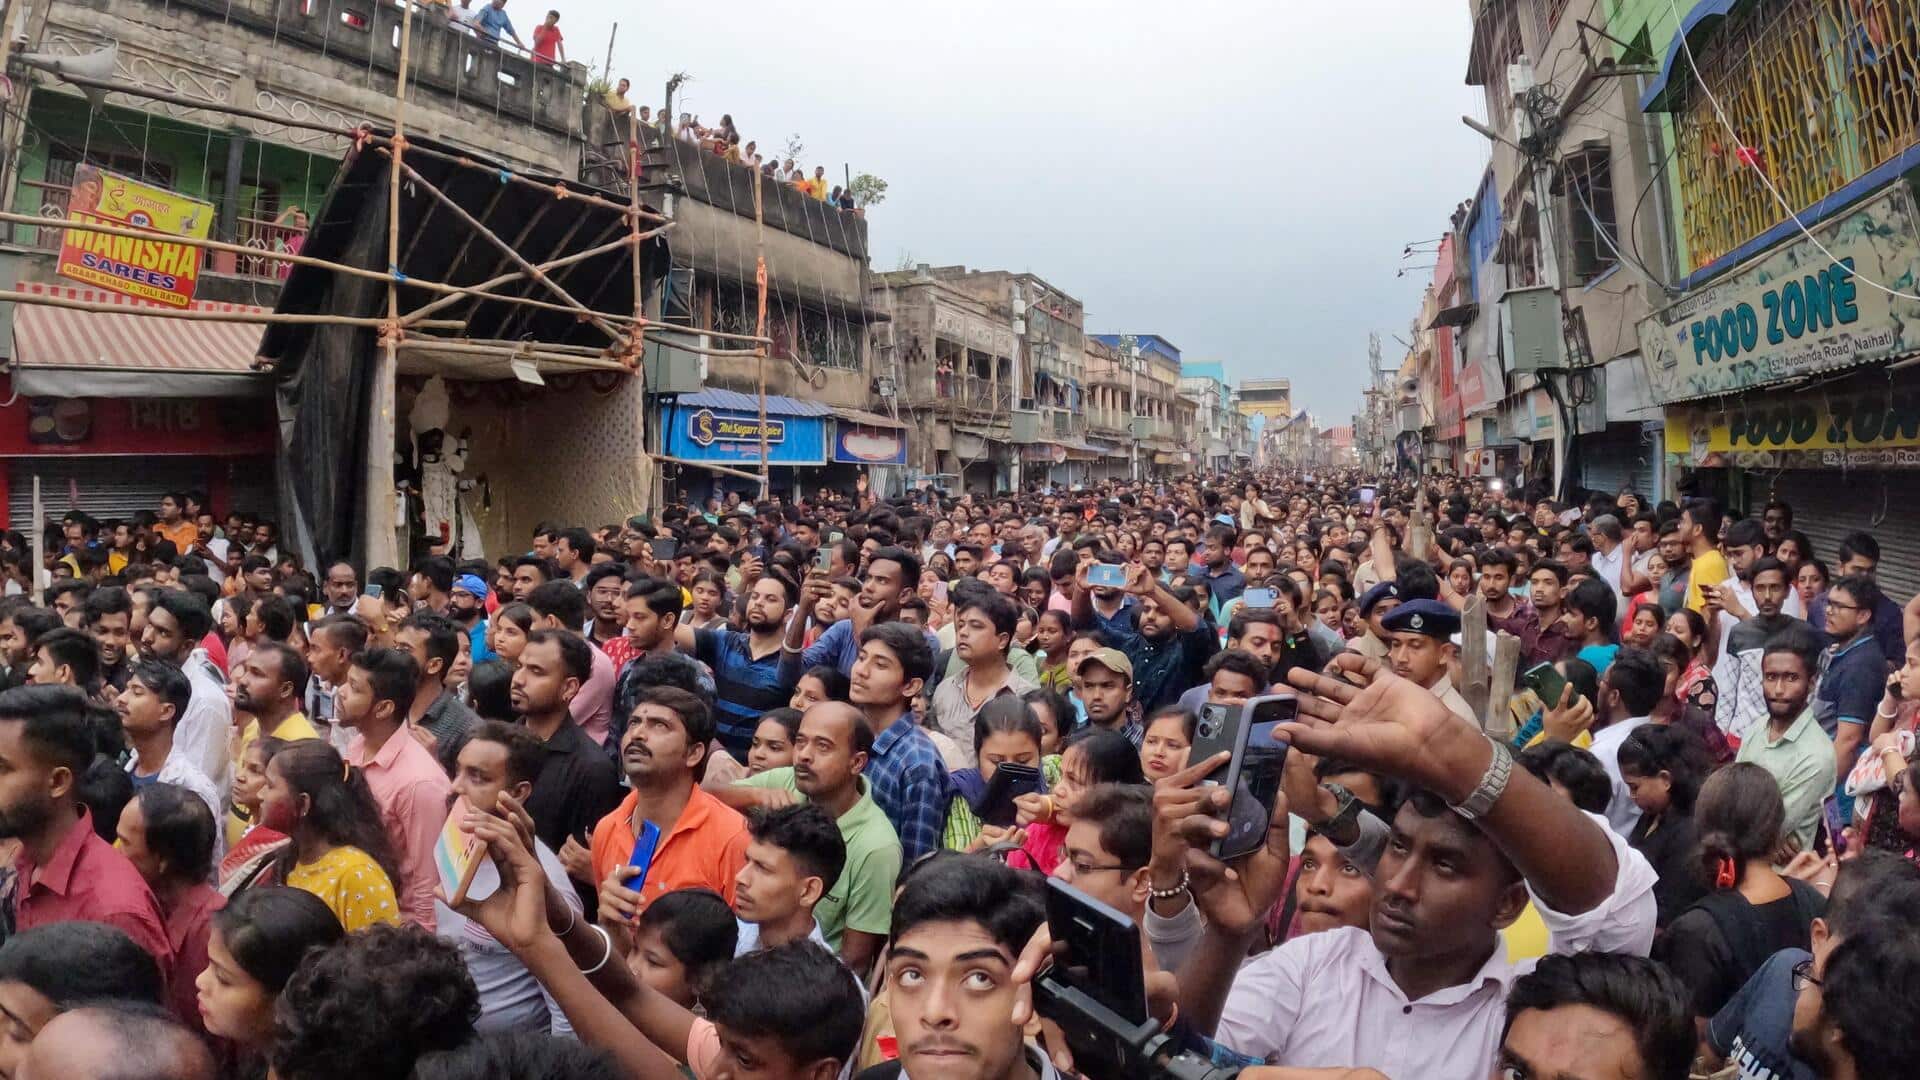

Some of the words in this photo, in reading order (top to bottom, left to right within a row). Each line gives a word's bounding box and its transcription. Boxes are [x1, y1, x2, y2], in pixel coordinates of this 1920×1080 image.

[66, 212, 196, 280] MANISHA
[82, 253, 176, 289] SAREES
[139, 286, 158, 298] TULI
[160, 290, 186, 304] BATIK
[1691, 302, 1758, 365] FOOD
[1763, 257, 1858, 345] ZONE
[1854, 330, 1894, 352] Naihati
[1729, 402, 1819, 446] FOOD
